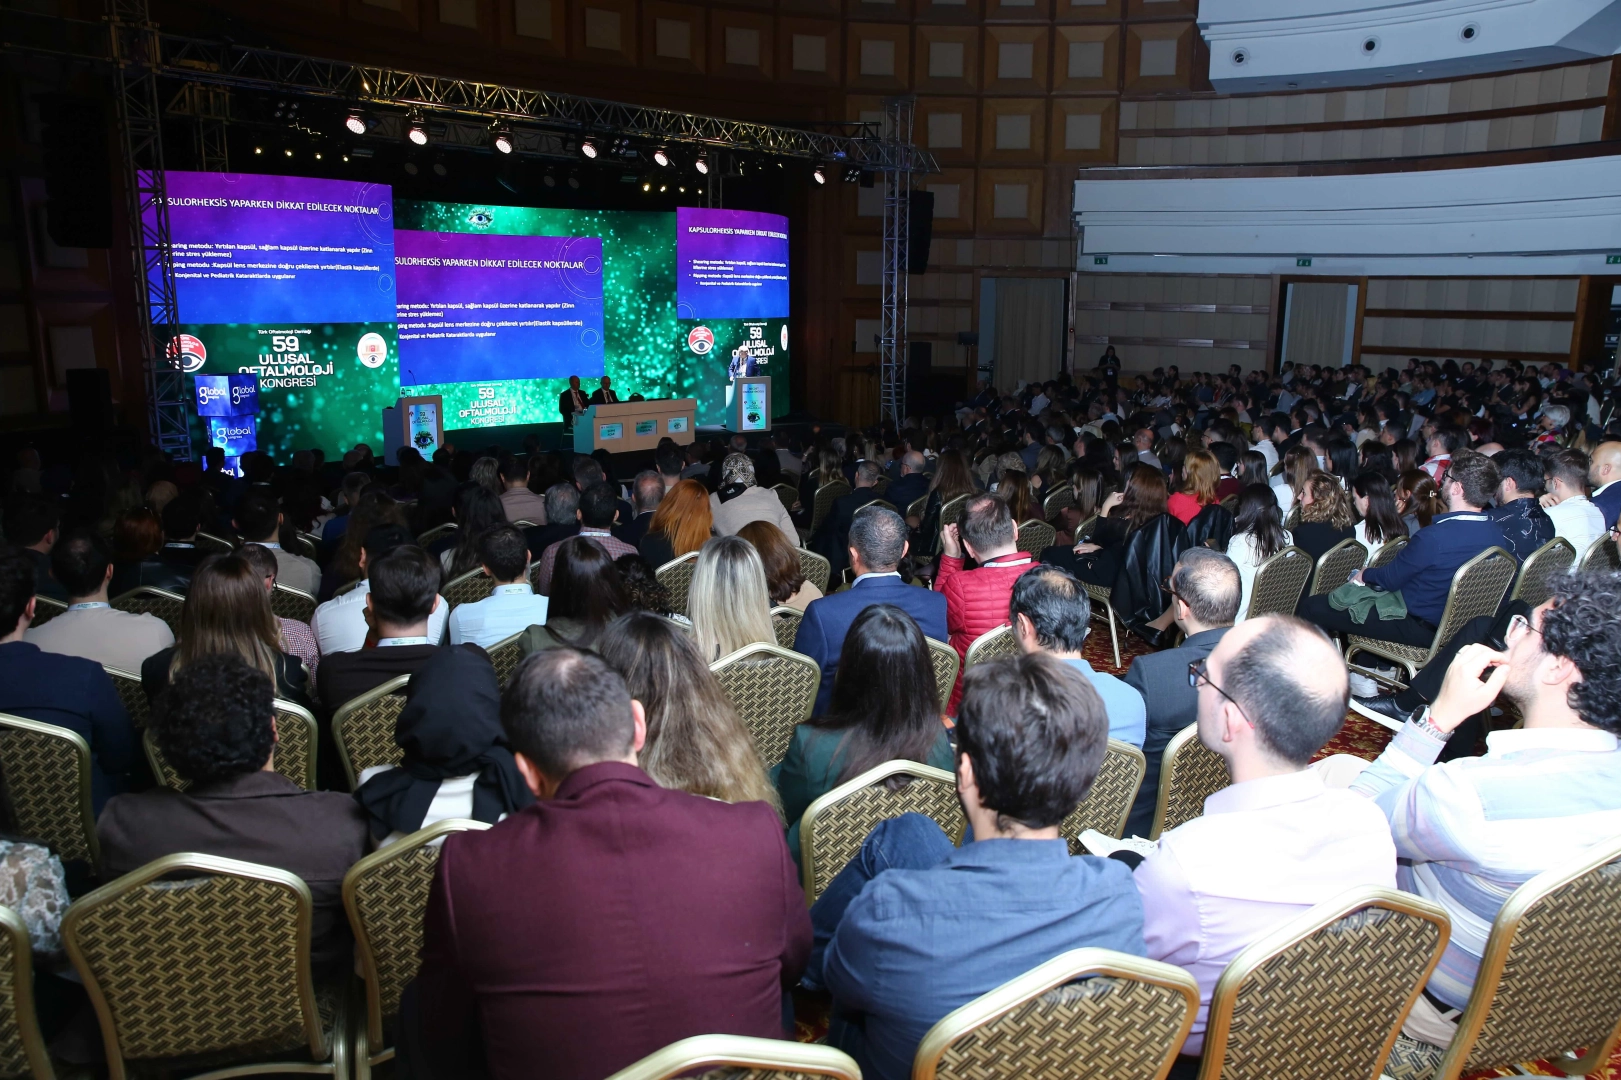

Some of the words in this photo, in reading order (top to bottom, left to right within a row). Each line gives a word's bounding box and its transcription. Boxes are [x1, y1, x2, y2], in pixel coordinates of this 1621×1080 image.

[152, 198, 228, 207] SULORHEKSİS
[230, 200, 274, 208] YAPARKEN
[276, 200, 304, 210] DİKKAT
[307, 202, 342, 212] EDİLECEK
[344, 206, 378, 214] NOKTALAR
[442, 258, 478, 267] YAPARKEN
[480, 258, 505, 268] DİKKAT
[508, 259, 542, 268] EDİLECEK
[750, 327, 762, 339] 59
[272, 336, 299, 352] 59
[259, 353, 314, 364] ULUSAL
[260, 376, 316, 388] KONGRESİ
[199, 386, 227, 404] global
[232, 385, 255, 404] global
[478, 388, 494, 399] 59
[470, 400, 504, 408] ULUSAL
[459, 406, 516, 418] OFTALMOLOJİ
[471, 415, 505, 424] KONGRESİ
[216, 426, 251, 444] global
